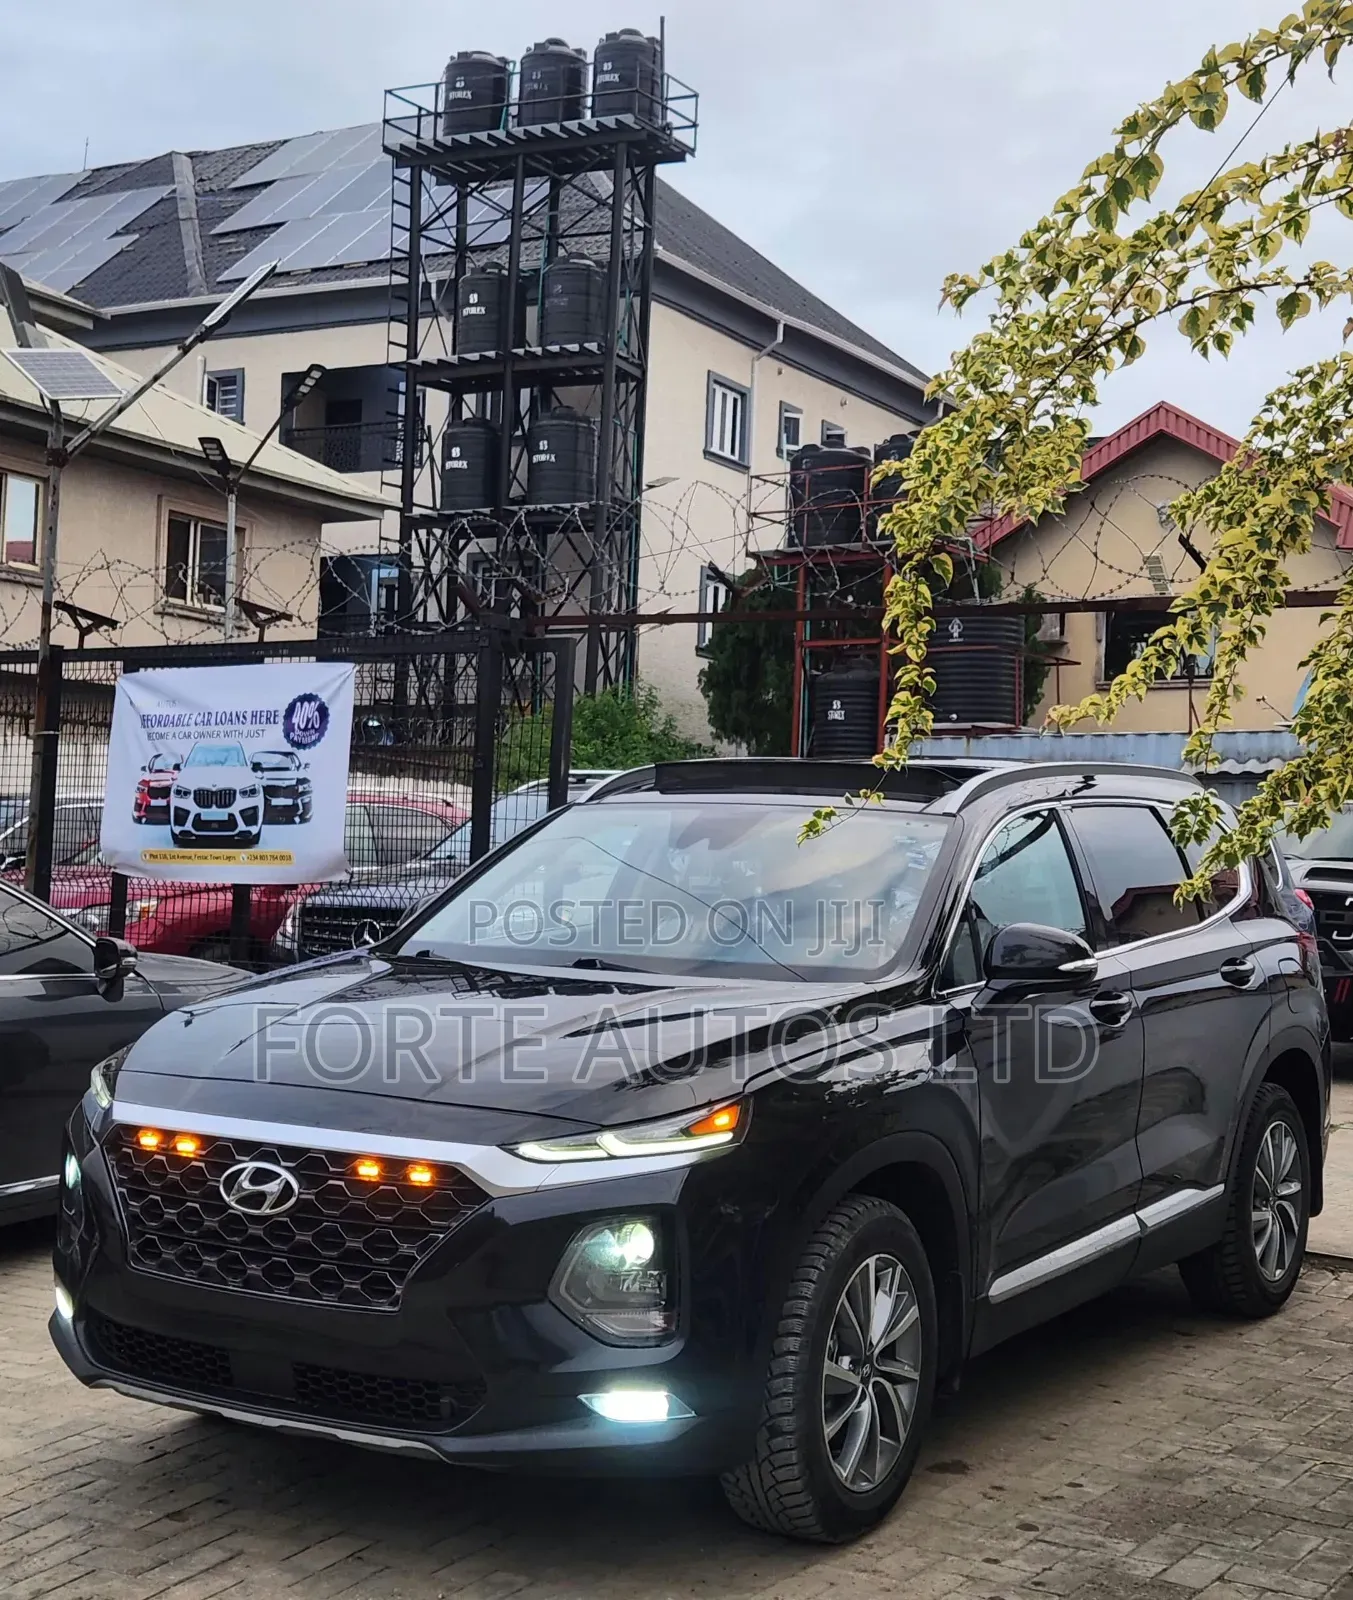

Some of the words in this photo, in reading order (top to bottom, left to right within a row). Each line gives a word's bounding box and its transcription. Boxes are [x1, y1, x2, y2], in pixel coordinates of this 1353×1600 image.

[194, 711, 213, 727] CAR
[214, 710, 248, 726] LOANS
[250, 710, 279, 725] HERE
[292, 701, 320, 730] 40%
[171, 731, 177, 740] A
[178, 731, 194, 740] CAR
[193, 730, 221, 740] OWNER
[223, 730, 243, 739] WITH
[245, 729, 266, 739] JUST
[289, 731, 320, 744] PAYMENT
